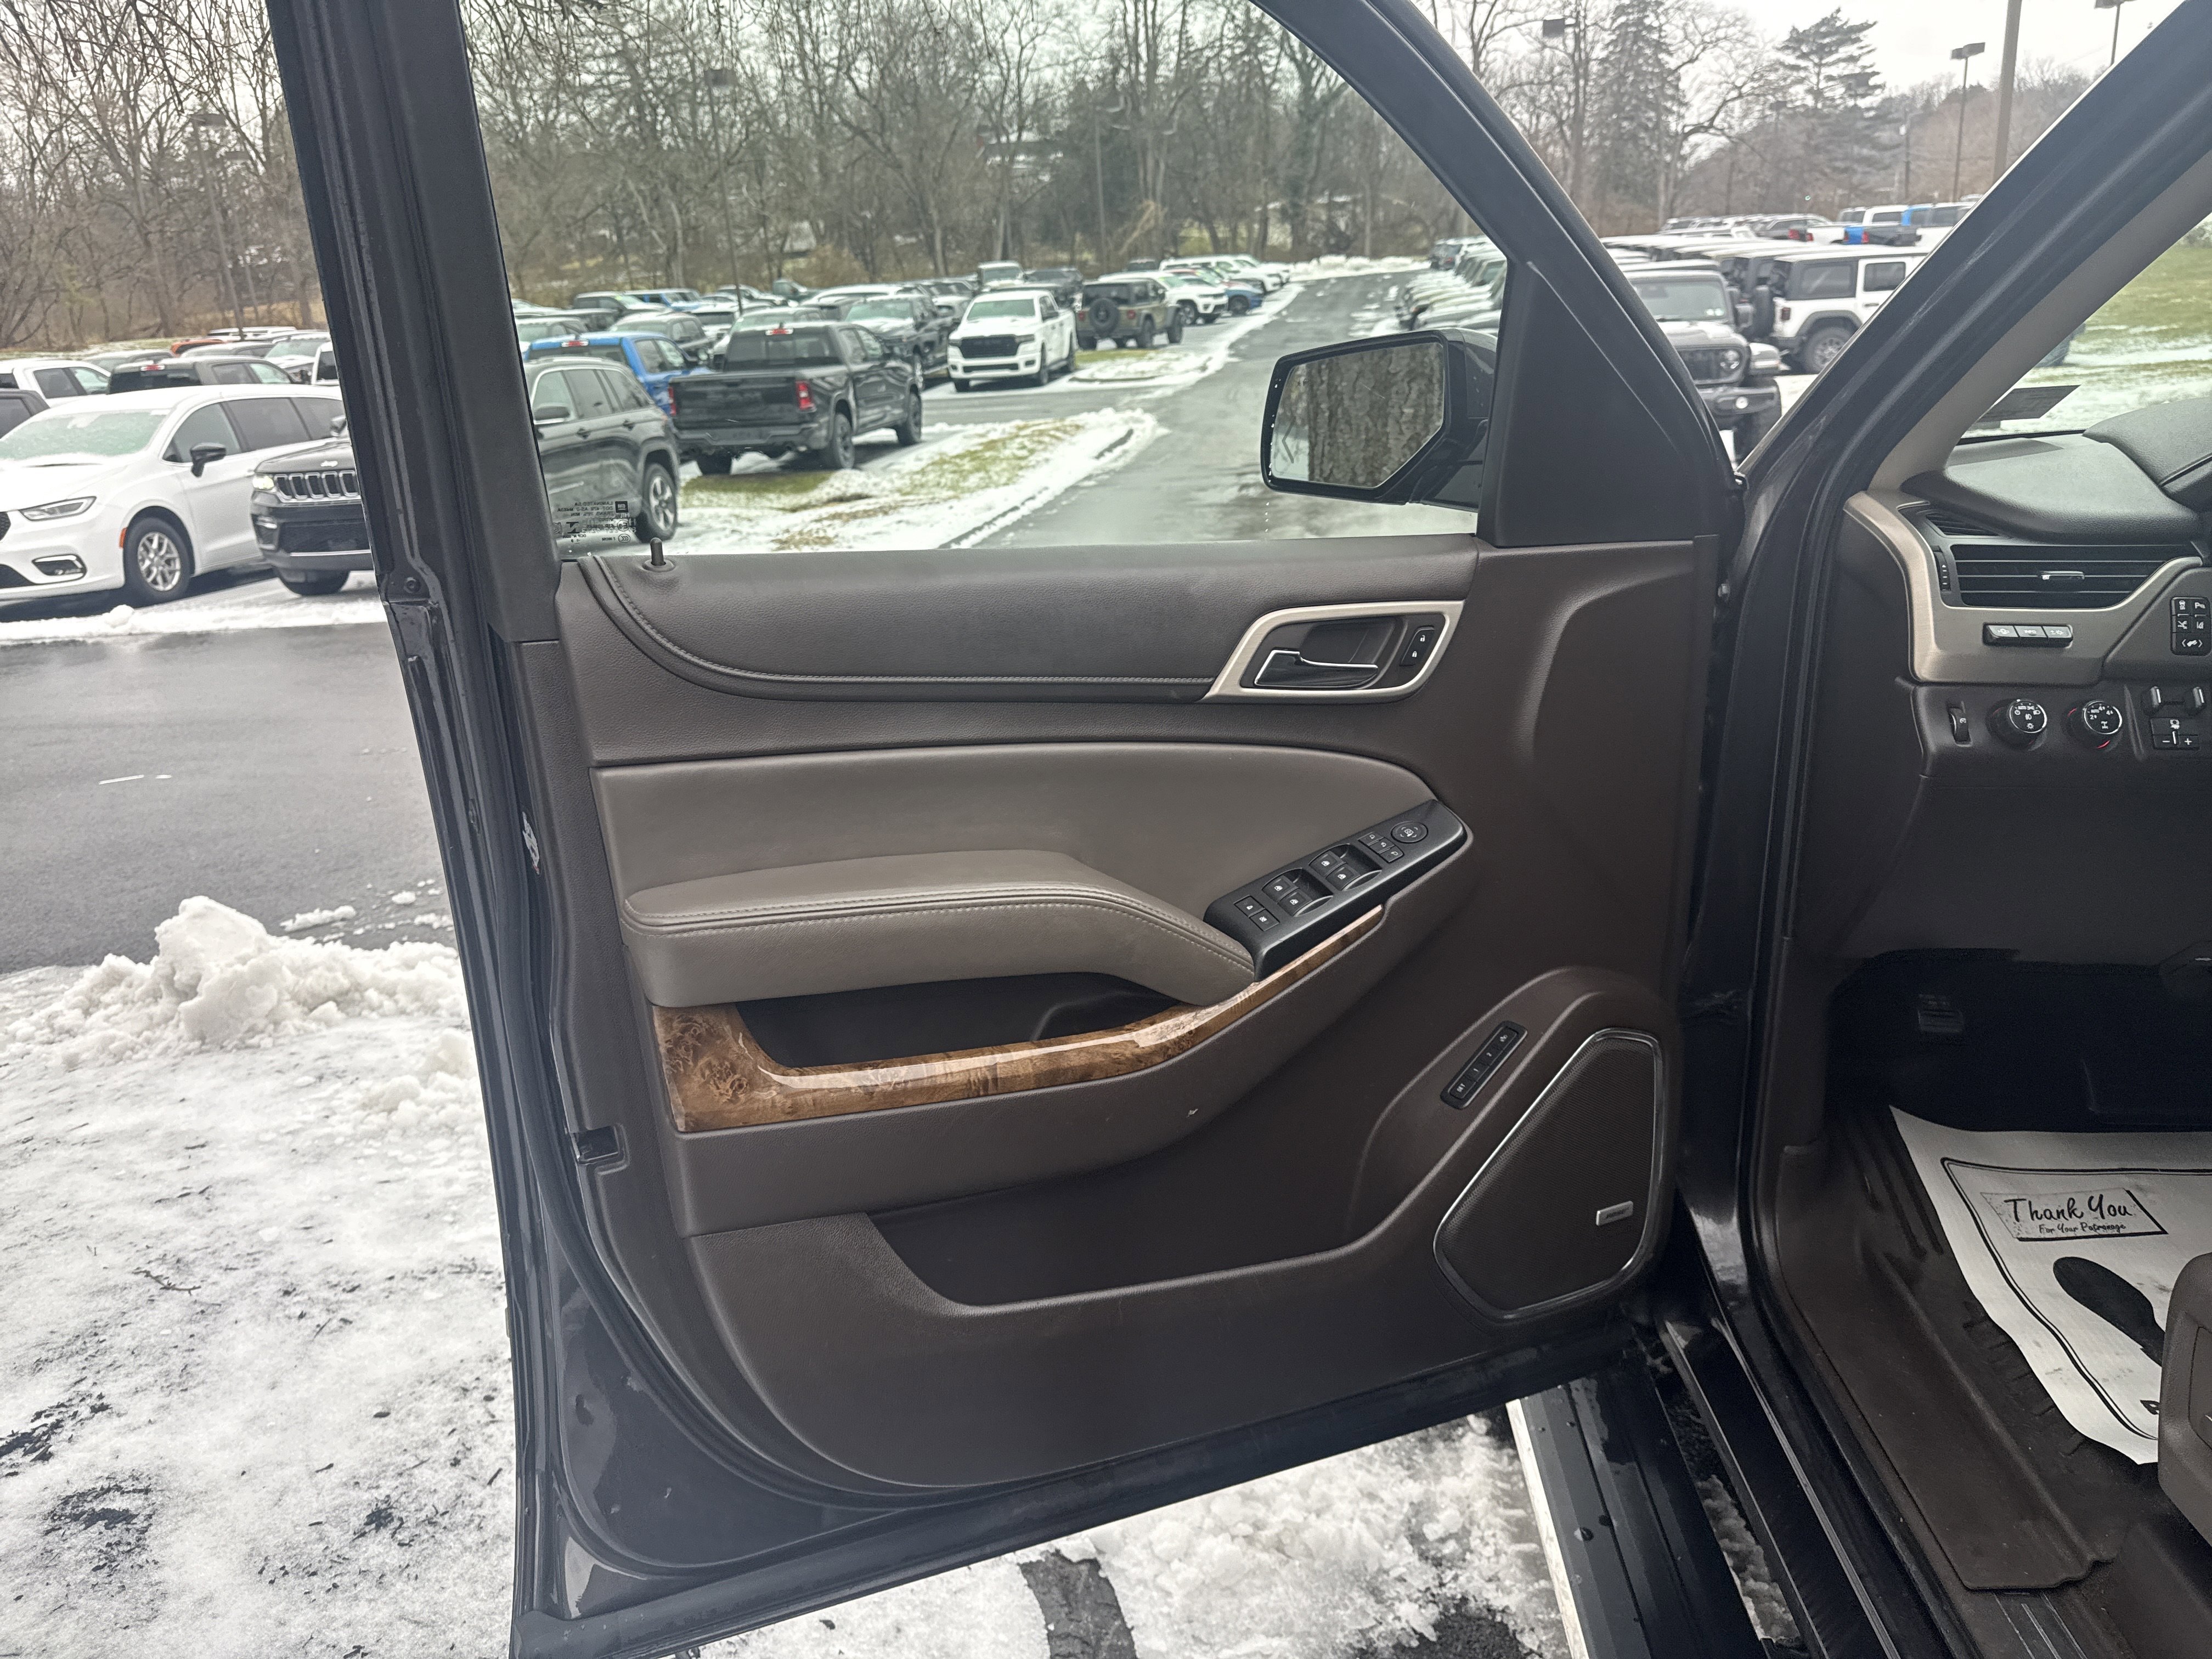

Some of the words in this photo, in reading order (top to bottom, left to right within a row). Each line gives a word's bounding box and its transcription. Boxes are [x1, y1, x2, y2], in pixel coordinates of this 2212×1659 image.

[2004, 1198, 2084, 1222] Thank
[2087, 1194, 2133, 1220] You
[2039, 1224, 2055, 1234] For
[2057, 1223, 2078, 1233] Your
[2080, 1222, 2126, 1234] Patronage
